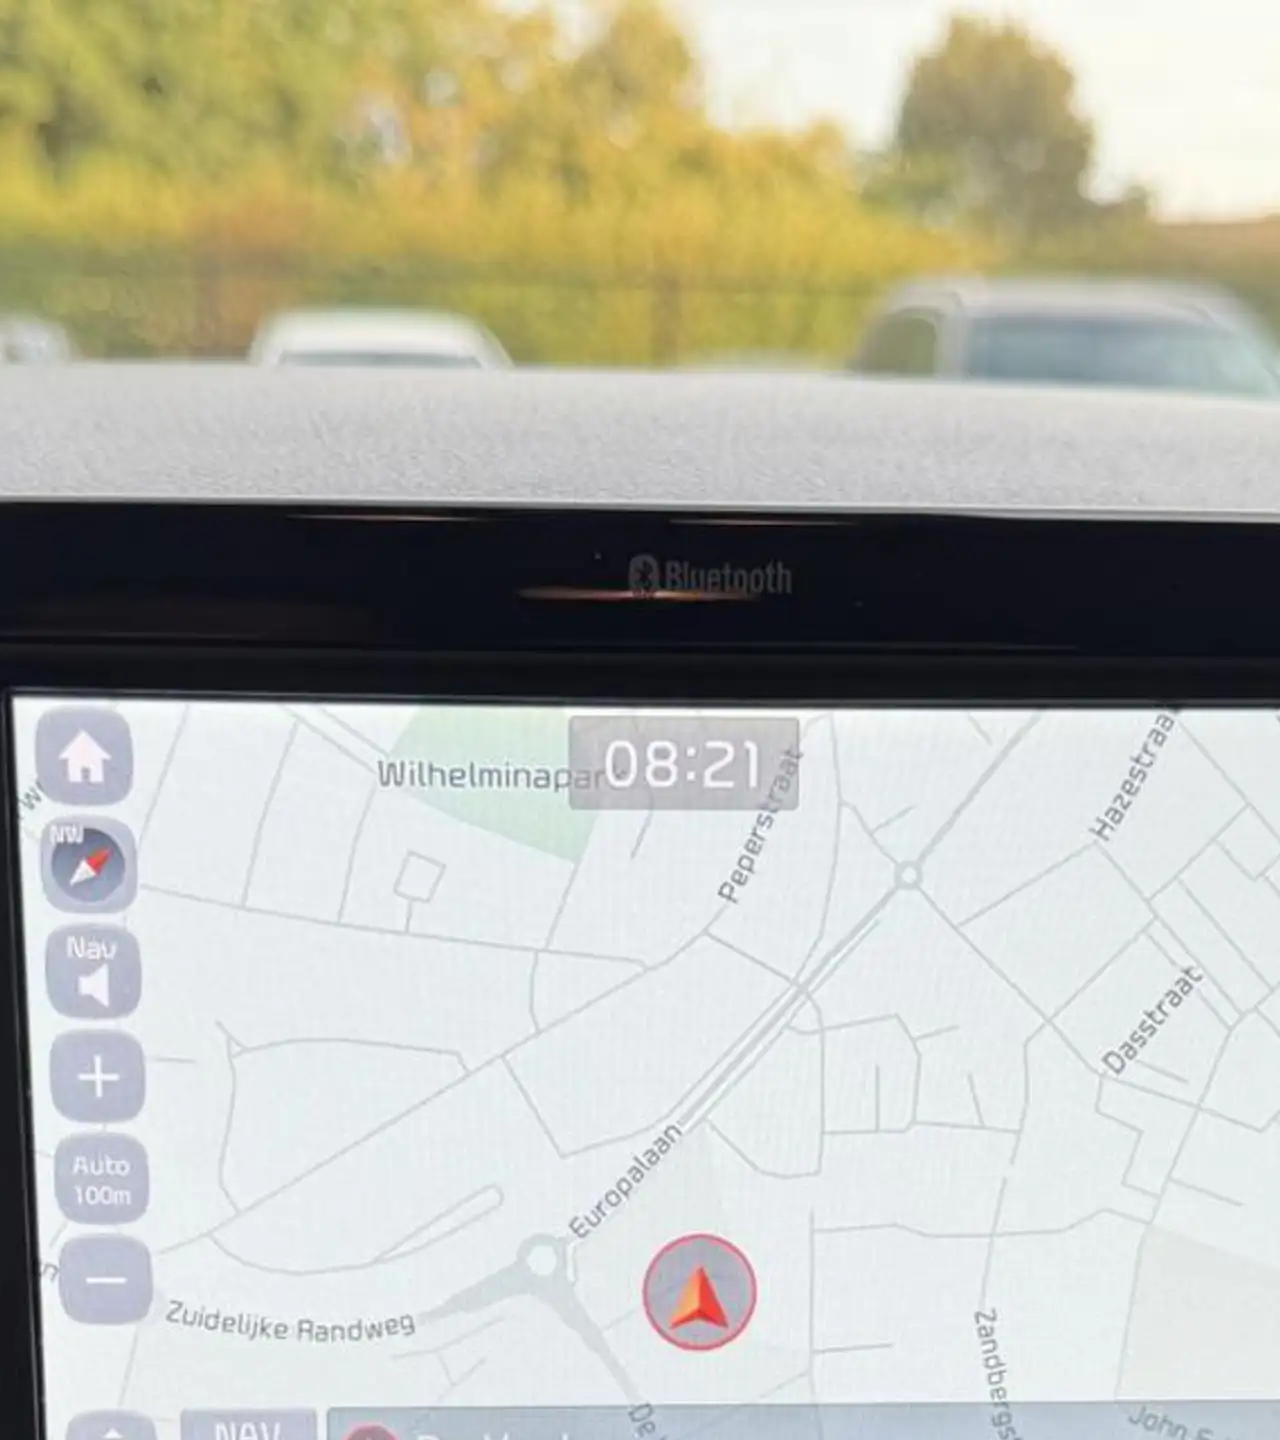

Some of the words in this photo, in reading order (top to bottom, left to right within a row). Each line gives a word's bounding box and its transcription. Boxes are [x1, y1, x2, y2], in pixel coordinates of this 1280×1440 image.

[664, 559, 793, 595] Bluetooth
[604, 739, 760, 790] 08:21
[1088, 704, 1182, 842] Hazestraa
[718, 746, 805, 903] Peperstraat
[66, 935, 117, 960] Nav
[1102, 967, 1202, 1078] Dasstraat
[73, 1155, 131, 1177] Auto
[569, 1123, 683, 1240] Europalaan
[74, 1186, 132, 1206] 100m
[165, 1300, 289, 1342] Zuidelijke
[297, 1314, 417, 1344] Randweg
[628, 1402, 656, 1440] De
